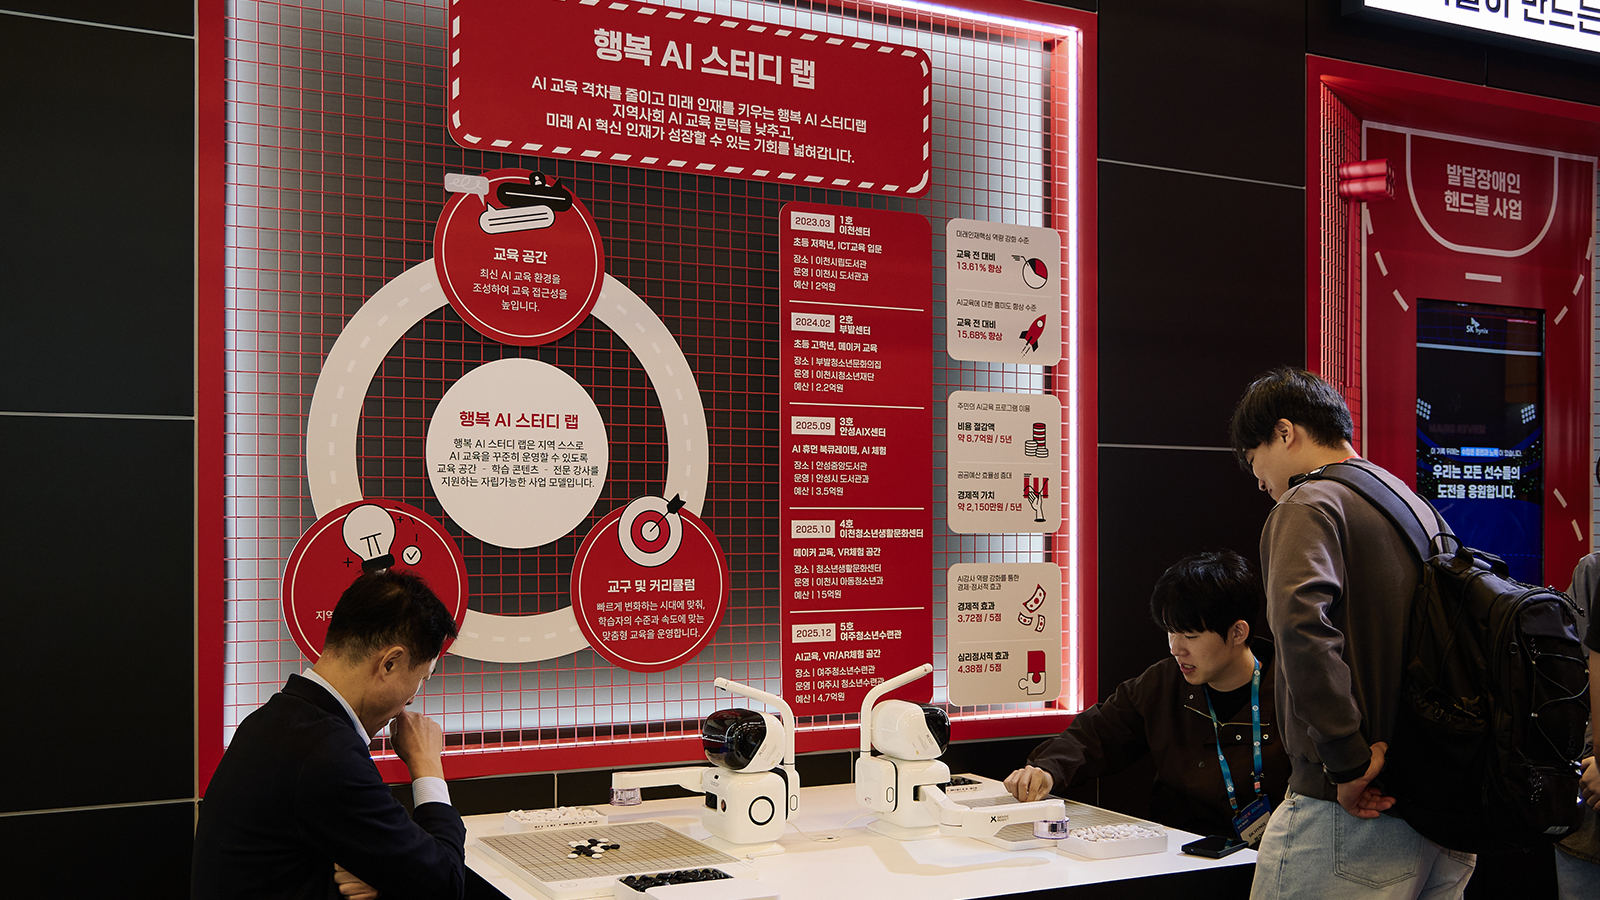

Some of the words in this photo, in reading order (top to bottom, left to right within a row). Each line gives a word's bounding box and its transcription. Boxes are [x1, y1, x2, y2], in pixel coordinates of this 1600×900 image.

[594, 28, 652, 66] 행복
[660, 40, 691, 70] AI
[701, 46, 781, 84] 스터디
[790, 58, 814, 89] 랩
[531, 76, 546, 90] AI
[550, 77, 578, 94] 교육
[582, 82, 621, 100] 격차를
[625, 87, 664, 105] 줄이고
[668, 94, 693, 110] 미래
[697, 97, 734, 115] 인재를
[738, 103, 774, 120] 키우는
[777, 108, 801, 124] 행복
[804, 112, 816, 125] AI
[820, 114, 866, 132] 스터디랩
[612, 103, 664, 123] 지역사회
[668, 111, 681, 124] AI
[685, 113, 711, 129] 교육
[714, 116, 751, 134] 문턱을
[755, 122, 793, 140] 낮추고,
[546, 112, 572, 129] 미래
[576, 117, 590, 130] AI
[595, 118, 621, 135] 혁신
[626, 122, 664, 140] 인재가
[668, 128, 706, 145] 성장할
[709, 133, 722, 146] 수
[726, 134, 750, 150] 있는
[754, 138, 790, 155] 기회를
[1446, 164, 1521, 194] 발달장애인
[1444, 190, 1489, 216] 핸드볼
[1493, 198, 1522, 220] 사업
[795, 216, 830, 227] 2023.03
[840, 215, 852, 225] 1호
[839, 225, 870, 237] 이천센터
[793, 238, 808, 246] 초등
[811, 239, 835, 249] 저학년,
[838, 241, 865, 251] ICT교육
[867, 244, 881, 253] 입문
[493, 247, 519, 261] 교육
[522, 249, 547, 264] 공간
[956, 249, 970, 258] 교육
[972, 251, 979, 259] 전
[981, 252, 995, 260] 대비
[793, 254, 808, 263] 장소
[815, 256, 866, 268] 이천시립도서관
[957, 261, 986, 271] 13.61%
[988, 264, 1002, 273] 향상
[480, 268, 497, 279] 최신
[500, 270, 511, 279] AI
[513, 271, 531, 282] 교육
[534, 272, 560, 284] 환경을
[472, 283, 509, 295] 조성하여
[512, 286, 529, 296] 교육
[532, 287, 567, 299] 접근성을
[793, 280, 808, 289] 예산
[815, 281, 835, 291] 2억원
[501, 299, 539, 311] 높입니다.
[795, 317, 830, 327] 2024.02
[839, 315, 854, 325] 2호
[839, 325, 870, 335] 부발센터
[1466, 325, 1474, 333] SK
[957, 330, 986, 339] 15.68%
[988, 331, 1002, 341] 향상
[459, 410, 490, 427] 행복
[494, 413, 510, 426] AI
[515, 413, 559, 428] 스터디
[564, 414, 578, 429] 랩
[839, 417, 854, 427] 3호
[796, 421, 830, 430] 2025.09
[839, 426, 885, 436] 안성AIX센터
[958, 422, 971, 430] 비용
[957, 433, 964, 442] 약
[966, 434, 993, 443] 8.7억원
[1000, 435, 1011, 443] 5년
[453, 438, 472, 448] 행복
[474, 439, 485, 448] AI
[488, 439, 514, 449] 스터디
[517, 439, 535, 450] 랩은
[537, 440, 555, 450] 지역
[557, 441, 583, 450] 스스로
[449, 451, 459, 460] AI
[462, 451, 490, 461] 교육을
[492, 451, 519, 462] 꾸준히
[522, 452, 548, 462] 운영할
[551, 453, 559, 462] 수
[562, 453, 588, 462] 있도록
[437, 463, 455, 473] 교육
[458, 463, 476, 474] 공간
[491, 464, 509, 474] 학습
[512, 464, 538, 474] 콘텐츠
[553, 465, 570, 475] 전문
[573, 465, 598, 475] 강사를
[1433, 464, 1461, 479] 우리는
[1463, 465, 1482, 479] 모든
[1484, 465, 1520, 480] 선수들의
[441, 476, 478, 486] 지원하는
[481, 476, 526, 487] 자립가능한
[528, 477, 546, 487] 사업
[549, 477, 594, 488] 모델입니다.
[958, 490, 978, 499] 경제적
[980, 491, 994, 499] 가치
[1437, 484, 1466, 498] 도전을
[1468, 484, 1516, 498] 응원합니다.
[957, 502, 964, 511] 약
[966, 502, 1003, 511] 2,150만원
[1010, 502, 1021, 511] 5년
[796, 525, 830, 533] 2025.10
[839, 519, 854, 528] 4호
[840, 528, 923, 538] 이천청소년생활문화센터
[607, 580, 631, 592] 교구
[635, 579, 645, 592] 및
[649, 578, 694, 591] 커리큘럼
[624, 601, 658, 611] 변화하는
[660, 600, 684, 610] 시대에
[958, 602, 978, 610] 경제적
[980, 601, 994, 610] 효과
[598, 615, 631, 626] 학습자의
[634, 614, 659, 625] 수준과
[661, 614, 685, 624] 속도에
[688, 613, 704, 623] 맞는
[957, 613, 982, 622] 3.72점
[989, 613, 1001, 621] 5점
[840, 622, 854, 631] 5호
[602, 630, 627, 641] 맞춤형
[630, 629, 654, 639] 교육을
[657, 627, 700, 639] 운영합니다.
[796, 628, 831, 637] 2025.12
[840, 630, 901, 640] 여주청소년수련관
[795, 651, 820, 661] AI교육,
[823, 650, 863, 659] VR/AR체험
[866, 649, 880, 658] 공간
[958, 652, 993, 661] 심리정서적
[995, 651, 1009, 659] 효과
[795, 669, 810, 677] 장소
[817, 665, 875, 676] 여주청소년수련관
[957, 664, 982, 673] 4.38점
[989, 663, 1001, 671] 5점
[795, 694, 810, 703] 예산
[817, 692, 844, 701] 4.7억원
